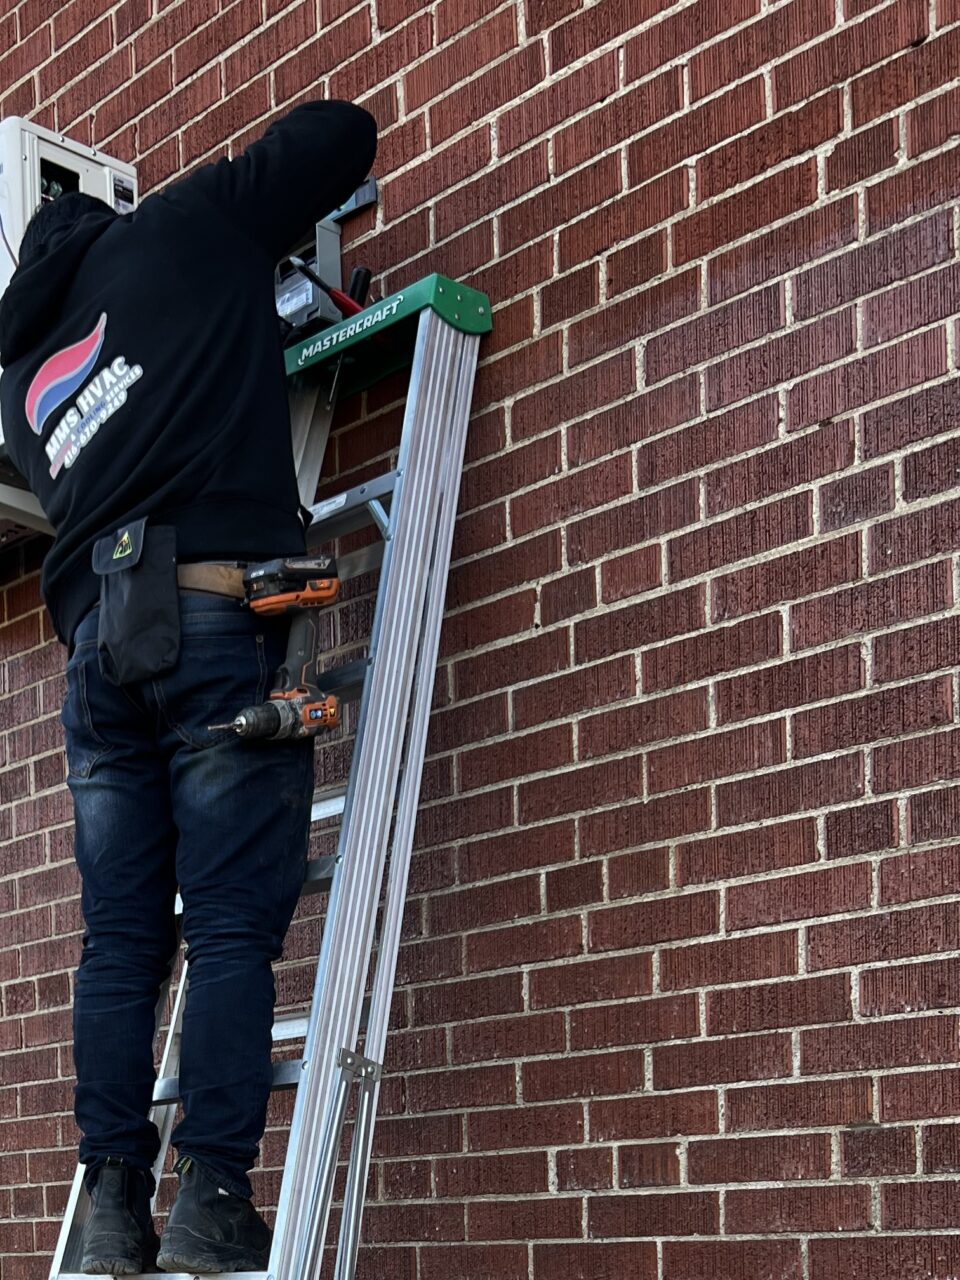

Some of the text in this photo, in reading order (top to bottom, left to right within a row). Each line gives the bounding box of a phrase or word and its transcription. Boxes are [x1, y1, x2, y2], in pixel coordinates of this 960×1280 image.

[299, 297, 402, 363] MASTERCRAFT
[46, 410, 80, 461] MMS
[78, 358, 128, 413] HVAC
[76, 401, 106, 433] COOLING
[105, 367, 141, 402] SERVICES
